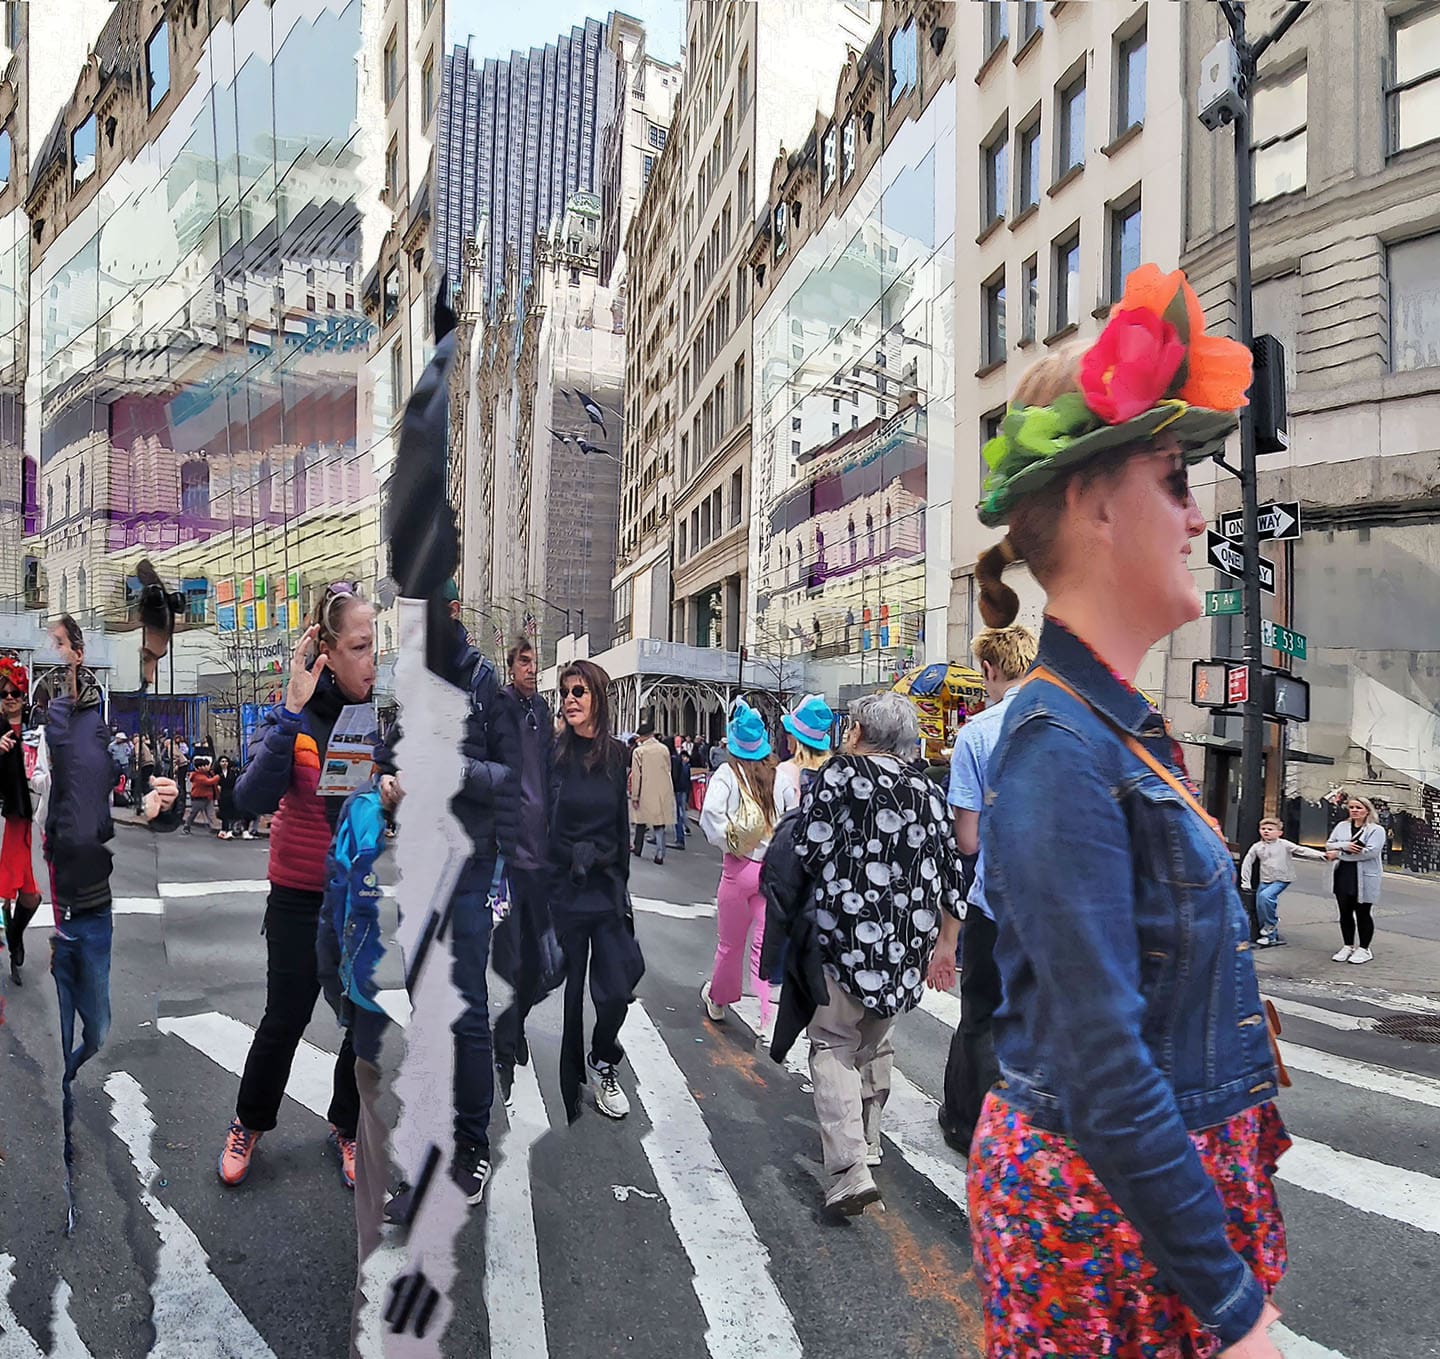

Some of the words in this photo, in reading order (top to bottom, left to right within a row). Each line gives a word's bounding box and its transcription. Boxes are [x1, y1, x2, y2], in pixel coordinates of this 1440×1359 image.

[1229, 519, 1244, 534] ON
[1260, 513, 1281, 531] WAY
[1221, 548, 1241, 567] ONE
[1211, 593, 1219, 612] 5
[1223, 592, 1235, 605] Av
[1272, 626, 1278, 645] E
[1283, 630, 1294, 651] 53
